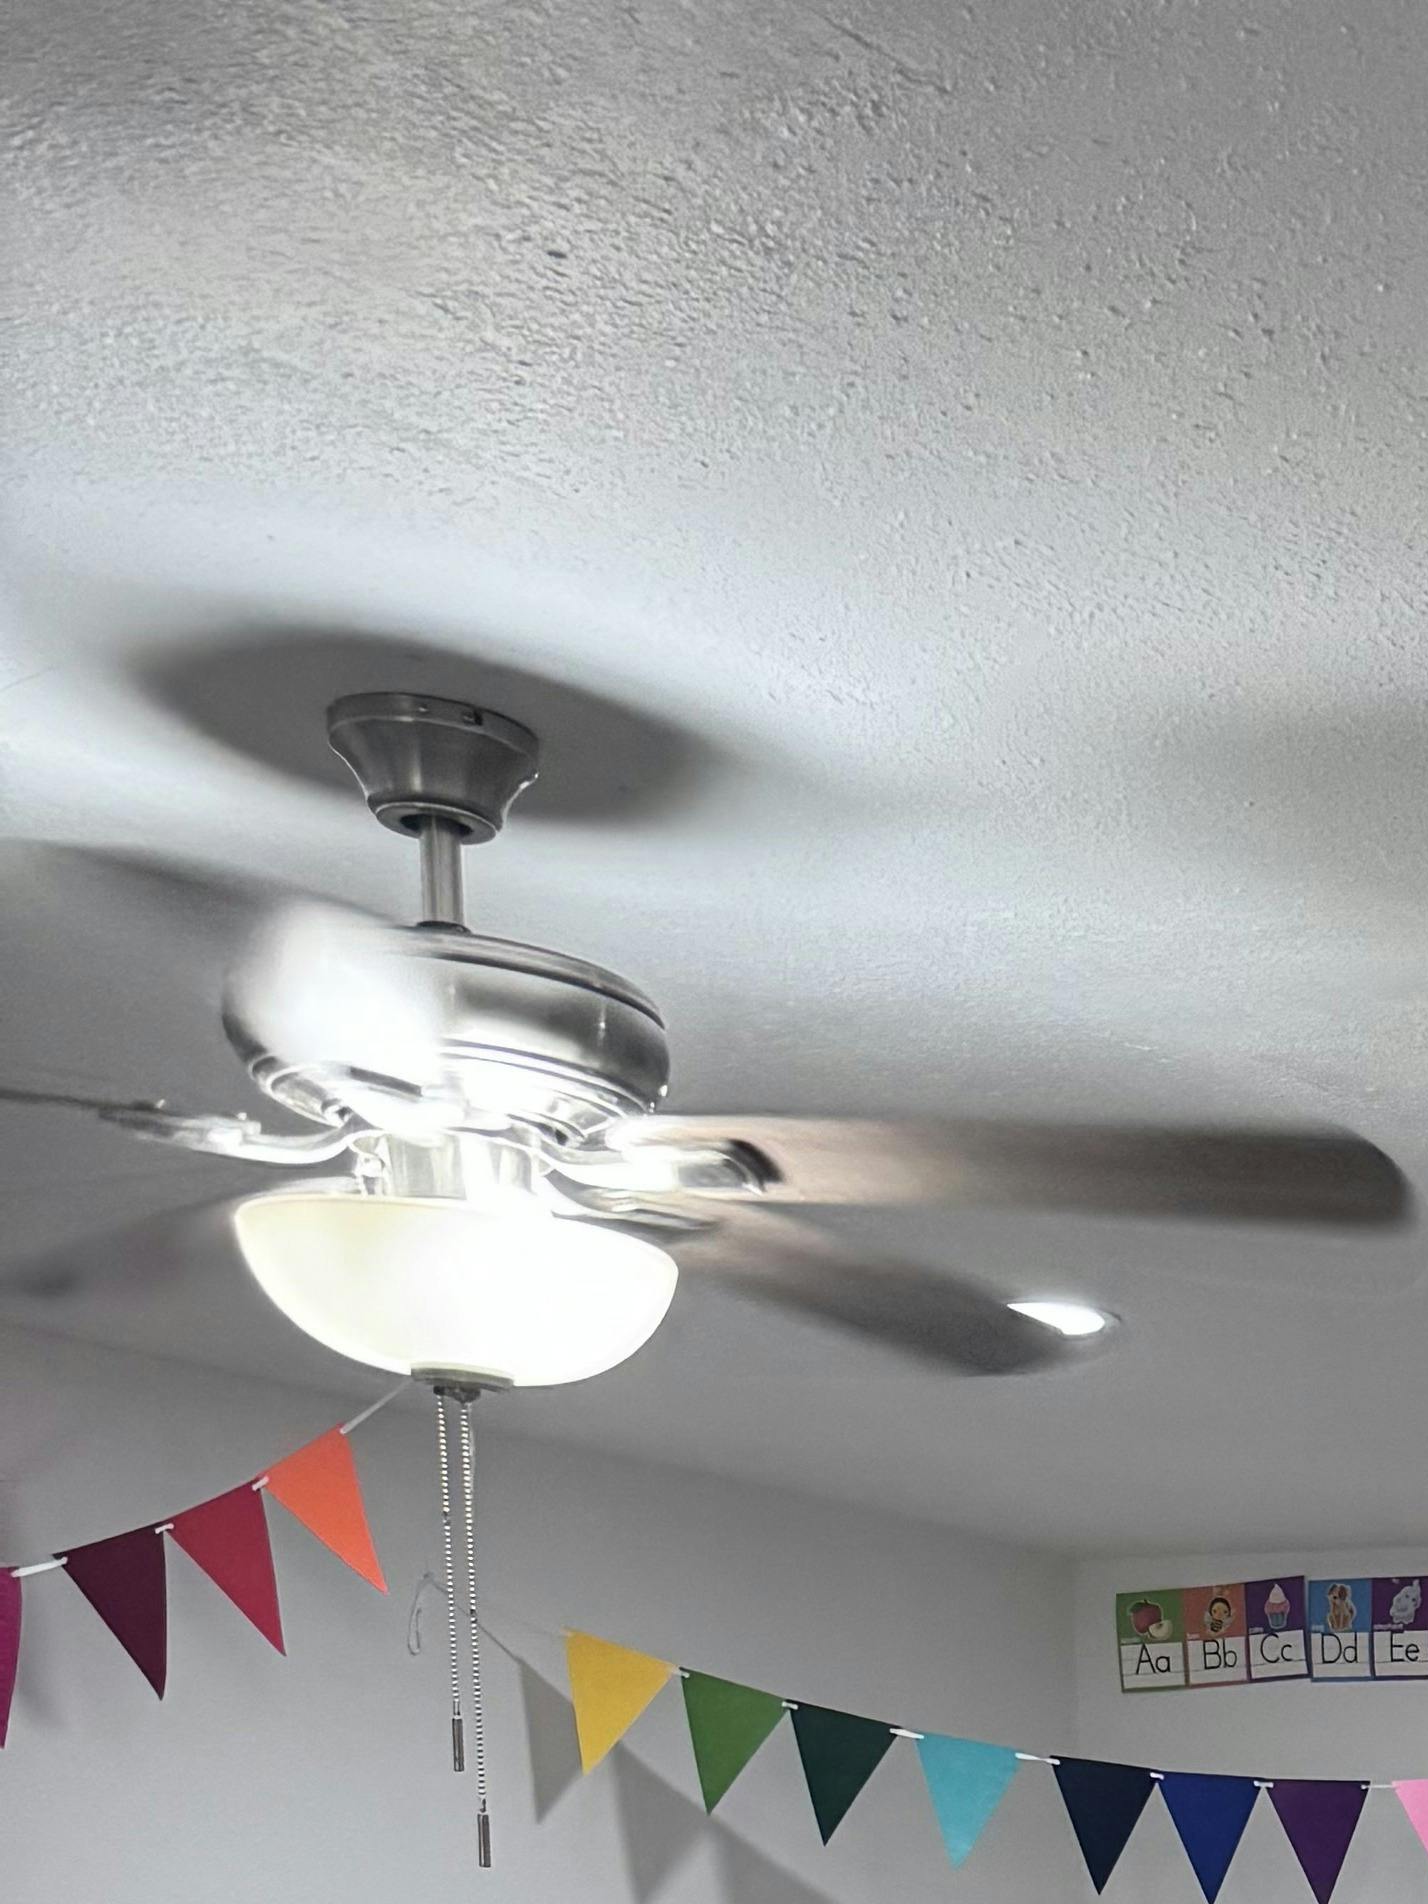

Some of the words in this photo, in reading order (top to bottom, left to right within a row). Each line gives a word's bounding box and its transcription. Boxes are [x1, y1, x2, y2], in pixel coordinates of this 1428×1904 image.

[1135, 1643, 1172, 1675] Aa
[1202, 1639, 1238, 1670] Bb
[1259, 1631, 1294, 1664] Cc
[1320, 1631, 1359, 1664] Dd
[1390, 1631, 1421, 1663] Ee
